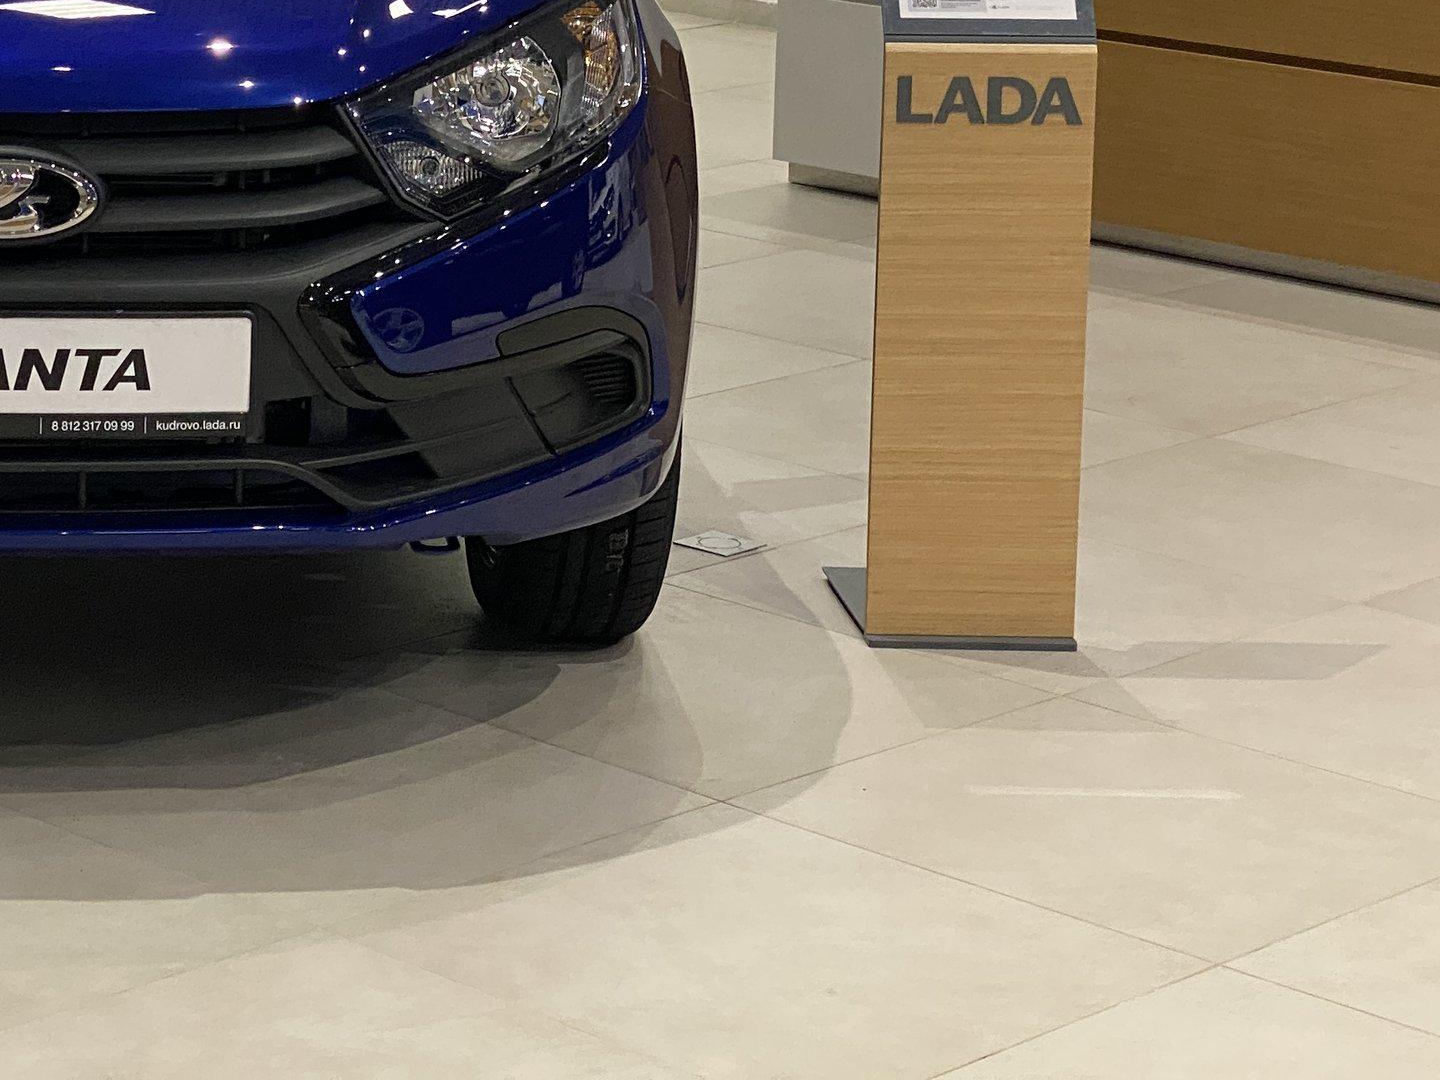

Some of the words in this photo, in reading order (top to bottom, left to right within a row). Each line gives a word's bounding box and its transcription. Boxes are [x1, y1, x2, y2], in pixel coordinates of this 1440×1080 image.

[896, 75, 1083, 126] LADA
[51, 420, 59, 431] 8
[61, 420, 81, 431] 812
[82, 420, 101, 431] 317
[103, 420, 118, 432] 09
[120, 420, 135, 432] 99
[155, 419, 241, 432] kudrovo.lada.ru
